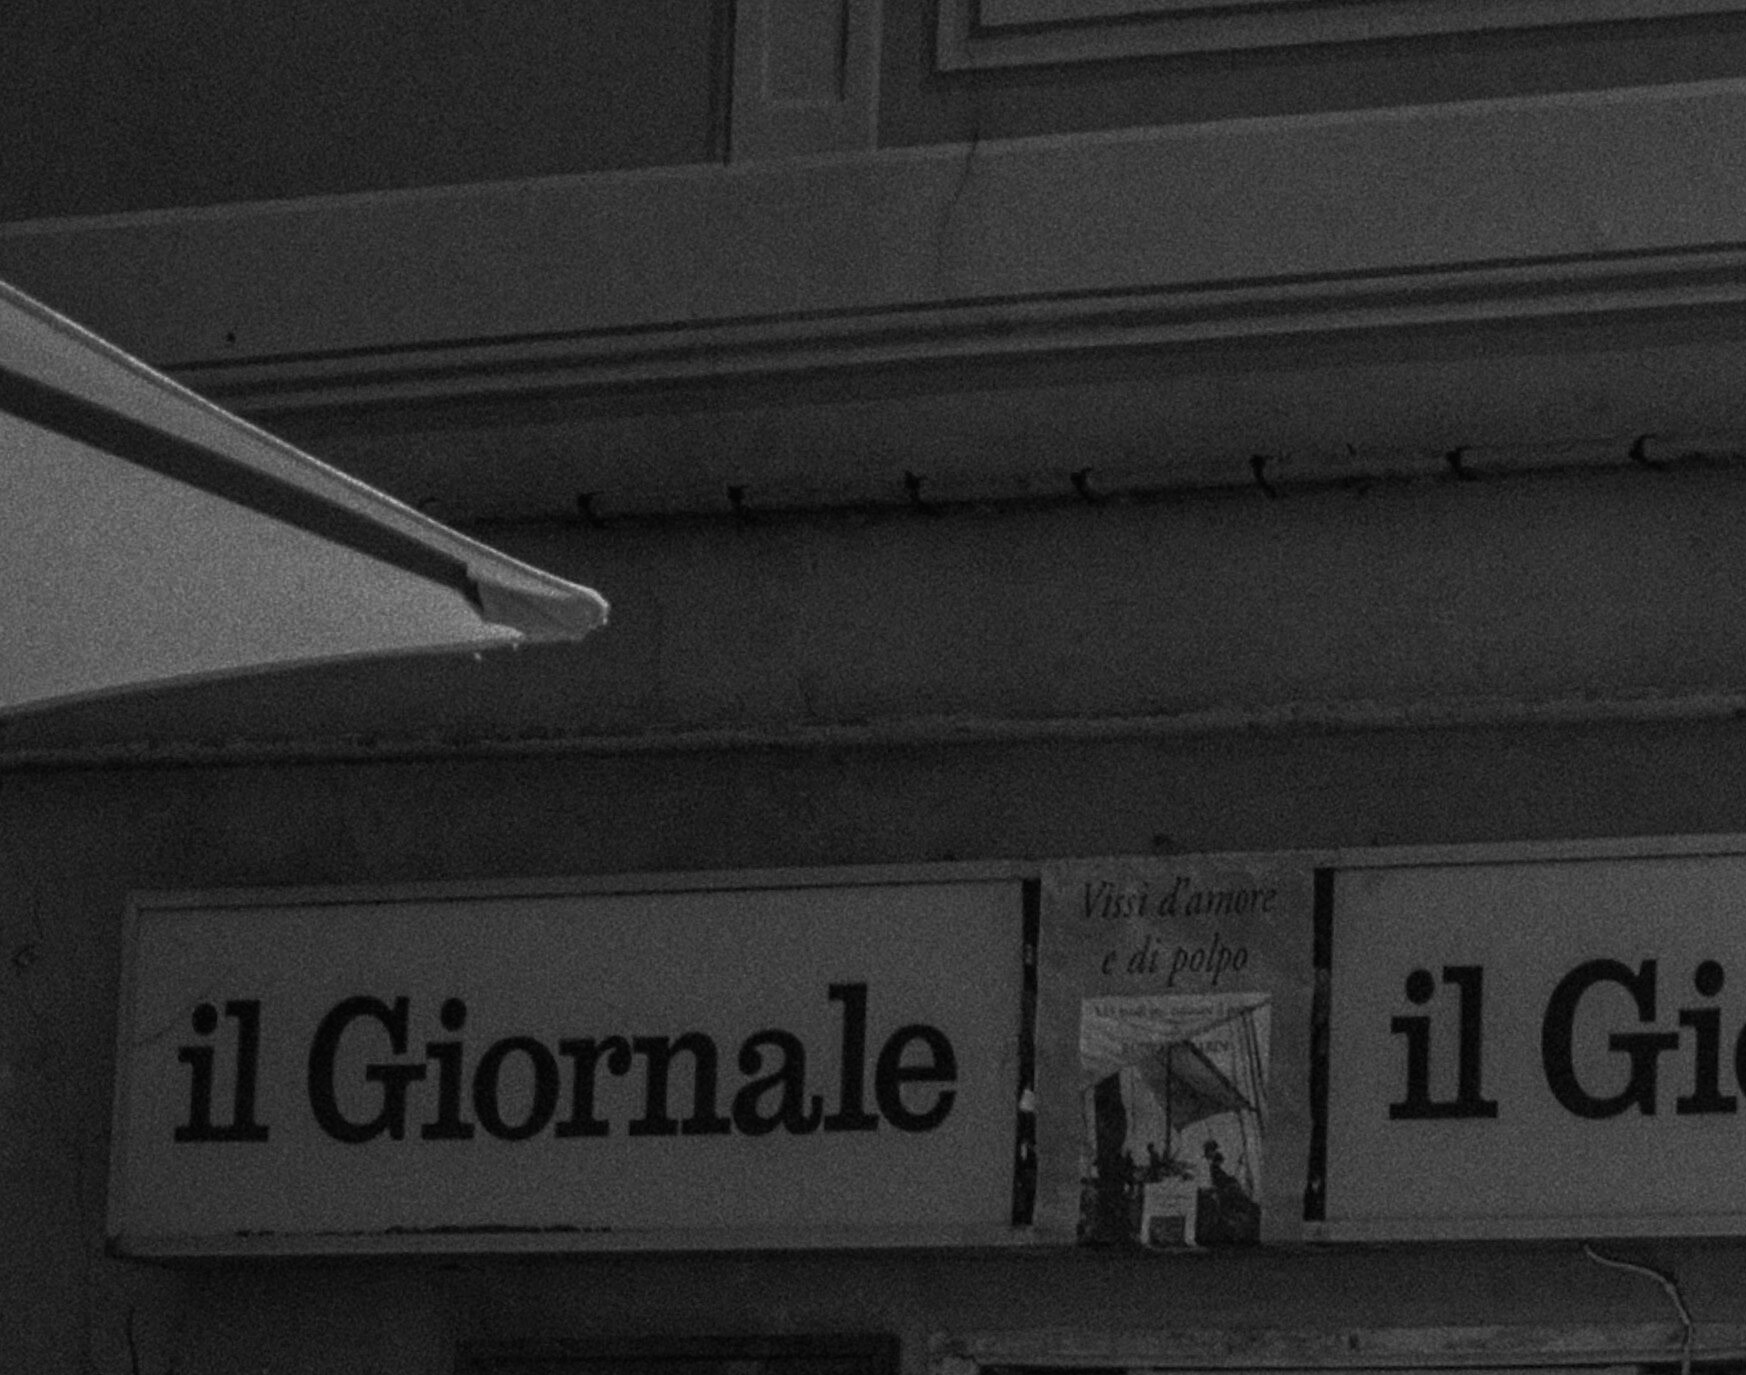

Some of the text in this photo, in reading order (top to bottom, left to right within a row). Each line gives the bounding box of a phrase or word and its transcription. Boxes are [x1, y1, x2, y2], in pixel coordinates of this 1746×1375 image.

[1084, 877, 1277, 919] Vissi d'amore
[1102, 932, 1248, 987] e di polpo
[174, 982, 958, 1144] il Giornale
[1389, 965, 1498, 1119] il
